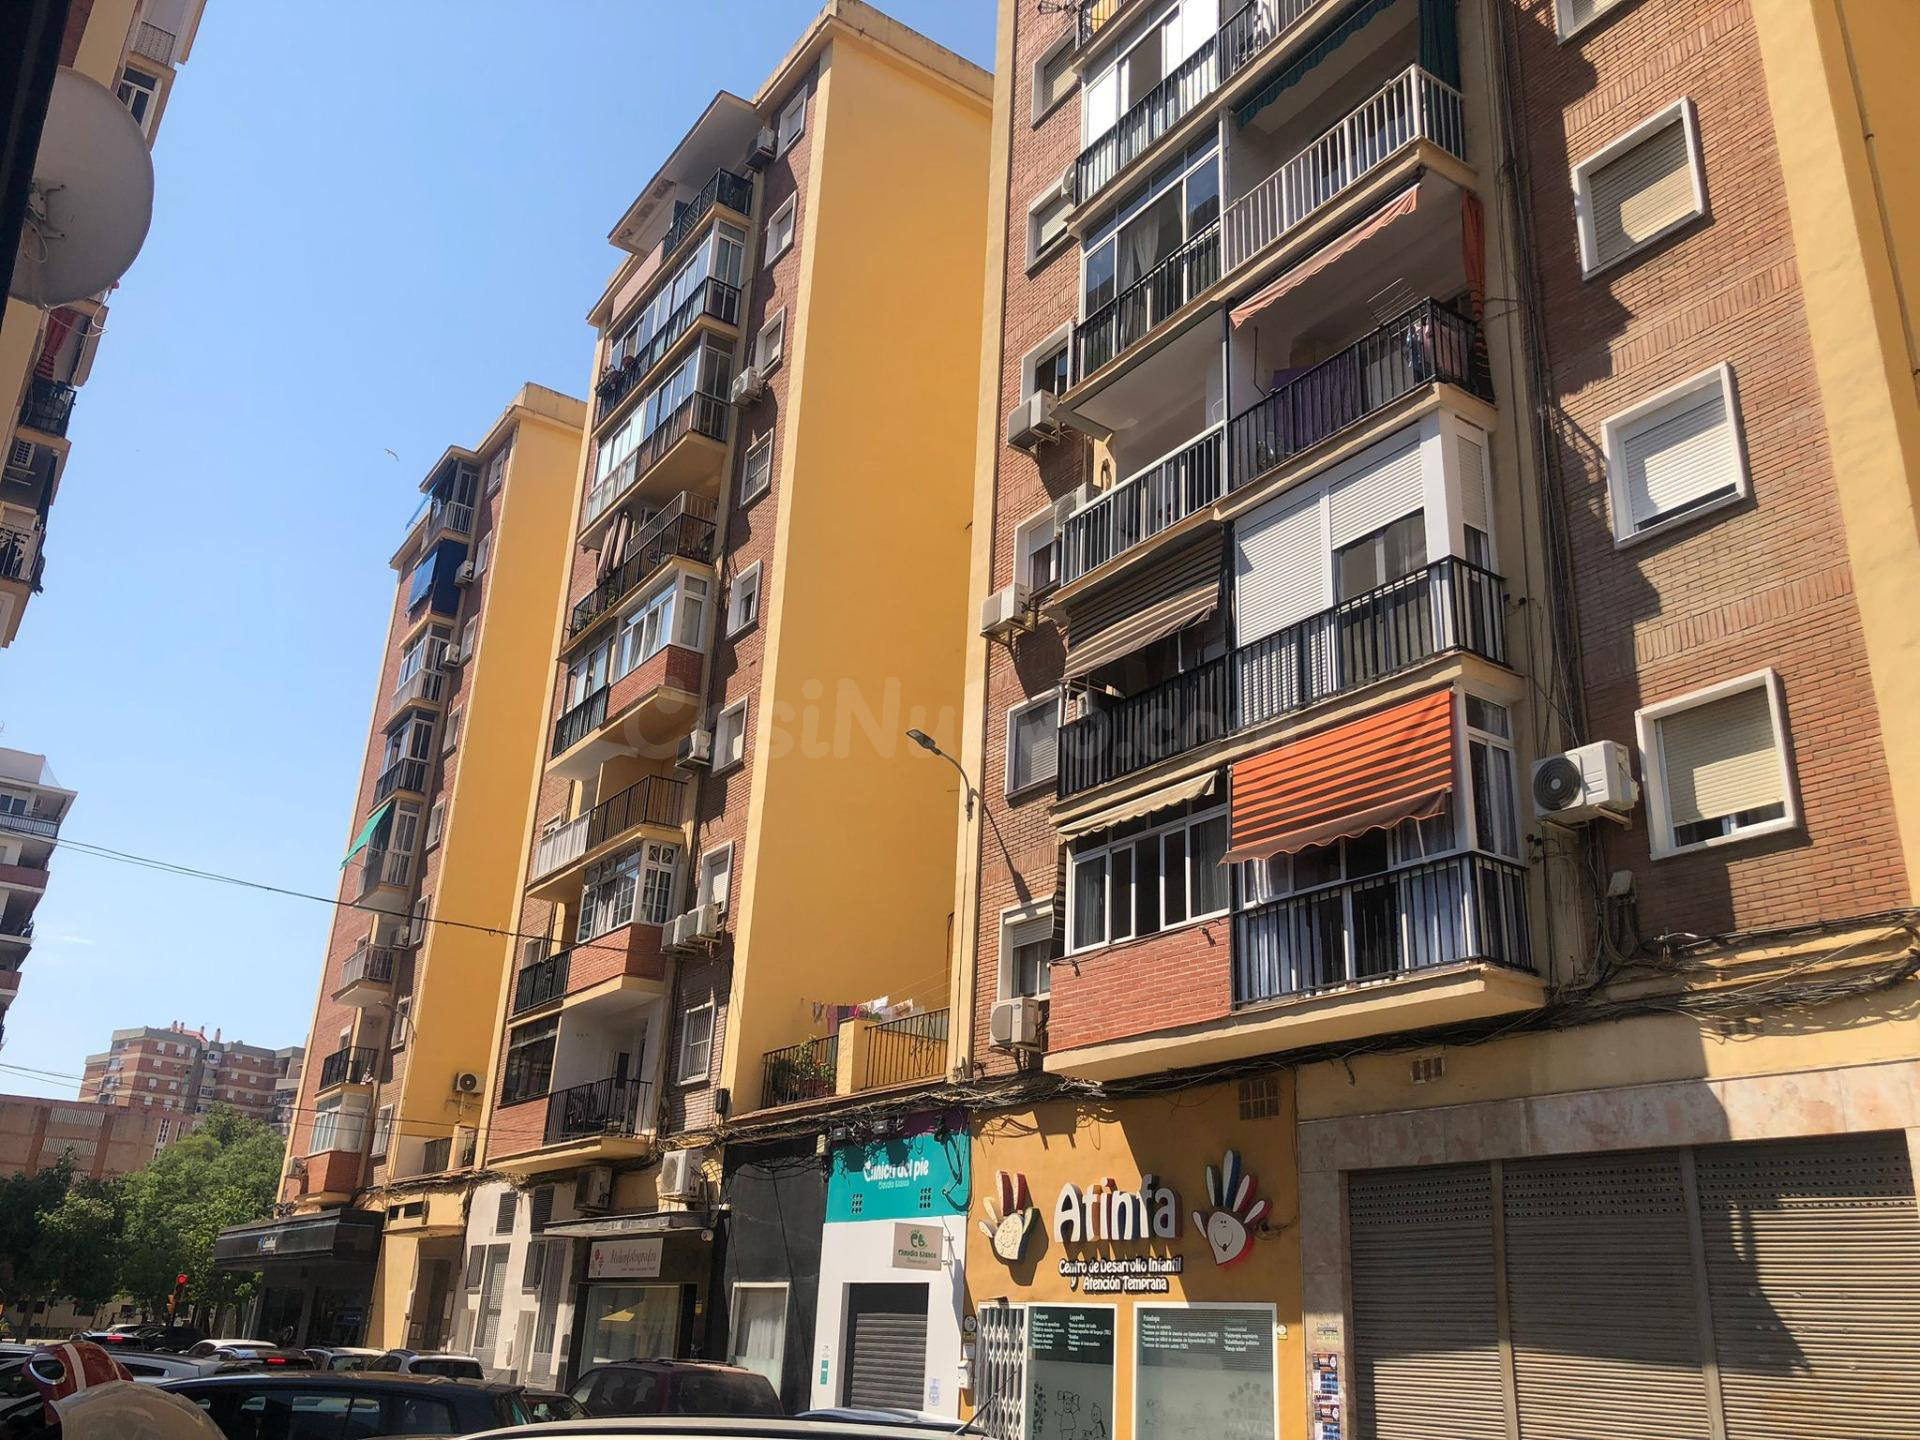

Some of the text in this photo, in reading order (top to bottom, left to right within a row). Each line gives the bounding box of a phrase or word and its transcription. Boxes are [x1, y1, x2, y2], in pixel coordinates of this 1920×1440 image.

[913, 1157, 929, 1181] pie
[1054, 1173, 1180, 1243] Atinfa
[1058, 1257, 1182, 1274] Centro de Desarrollo Infantil
[1082, 1275, 1121, 1291] Atención
[1122, 1275, 1168, 1291] Temprana
